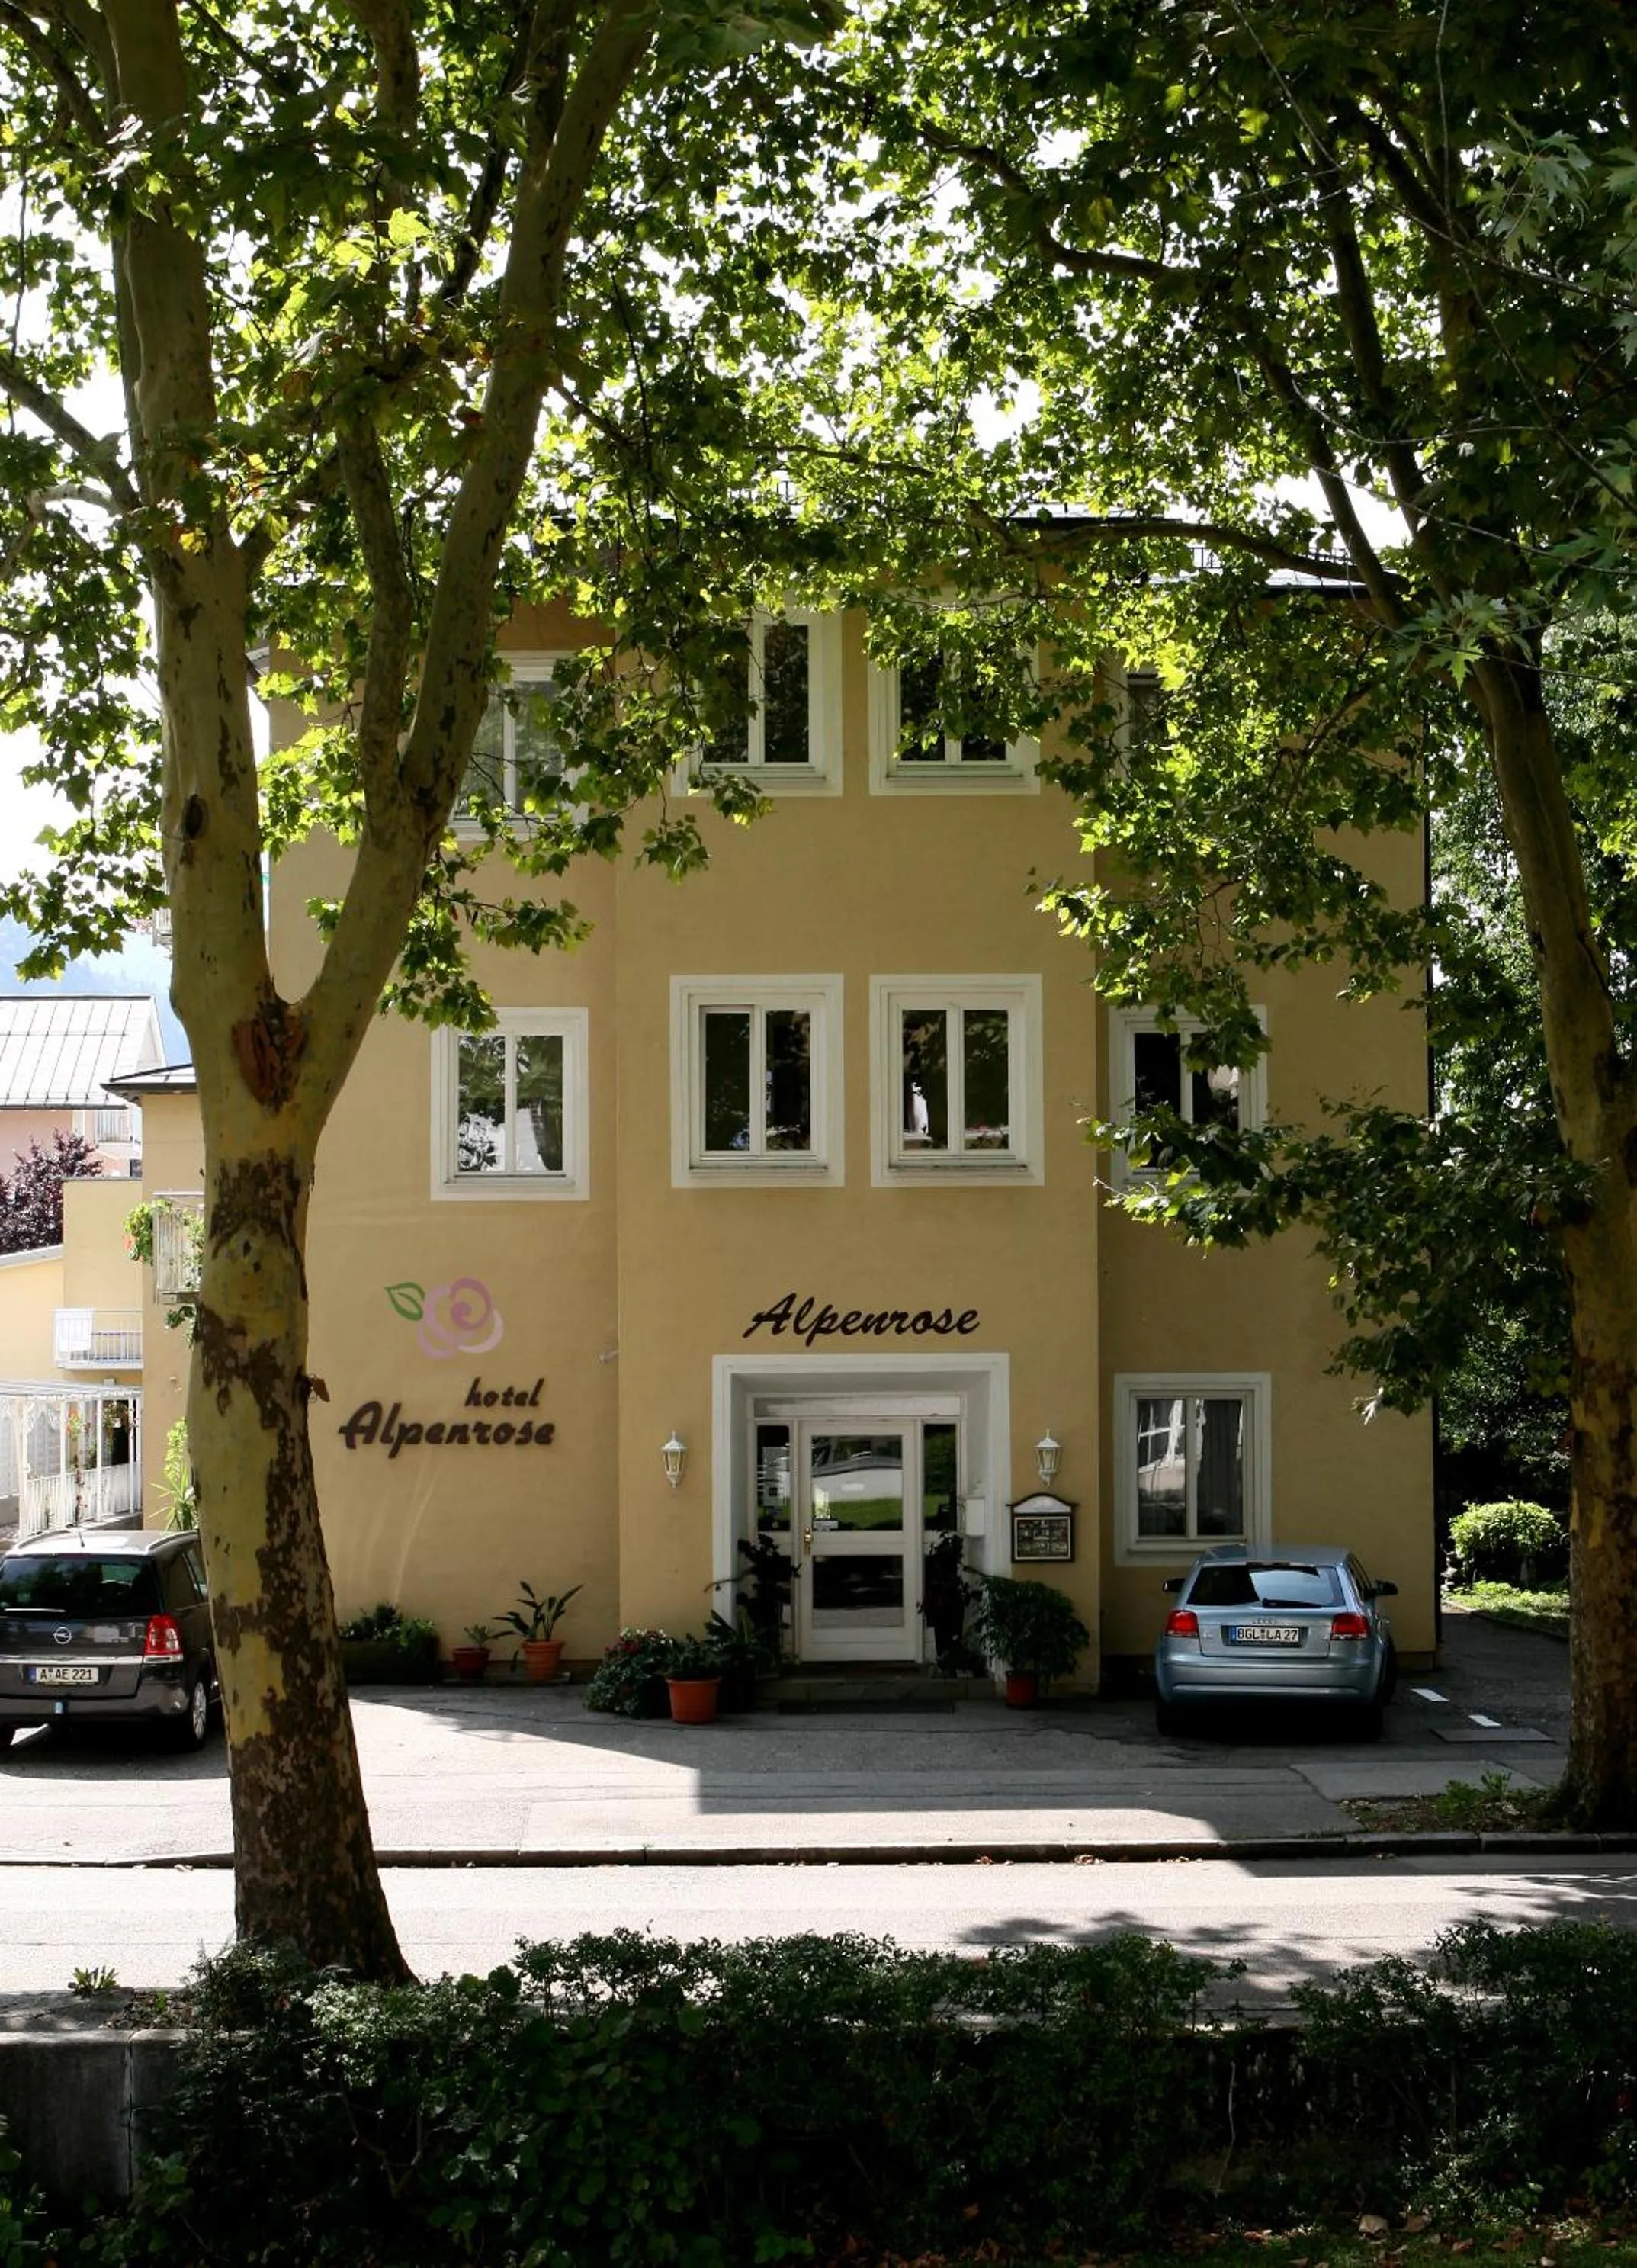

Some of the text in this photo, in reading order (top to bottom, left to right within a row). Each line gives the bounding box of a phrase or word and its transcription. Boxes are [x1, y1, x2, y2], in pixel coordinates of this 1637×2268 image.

[742, 1293, 980, 1347] Alpenrose
[464, 1377, 544, 1407] hotel
[339, 1400, 556, 1459] Alpenrose
[1237, 1627, 1298, 1640] BGL LA 27
[72, 1669, 92, 1680] 221
